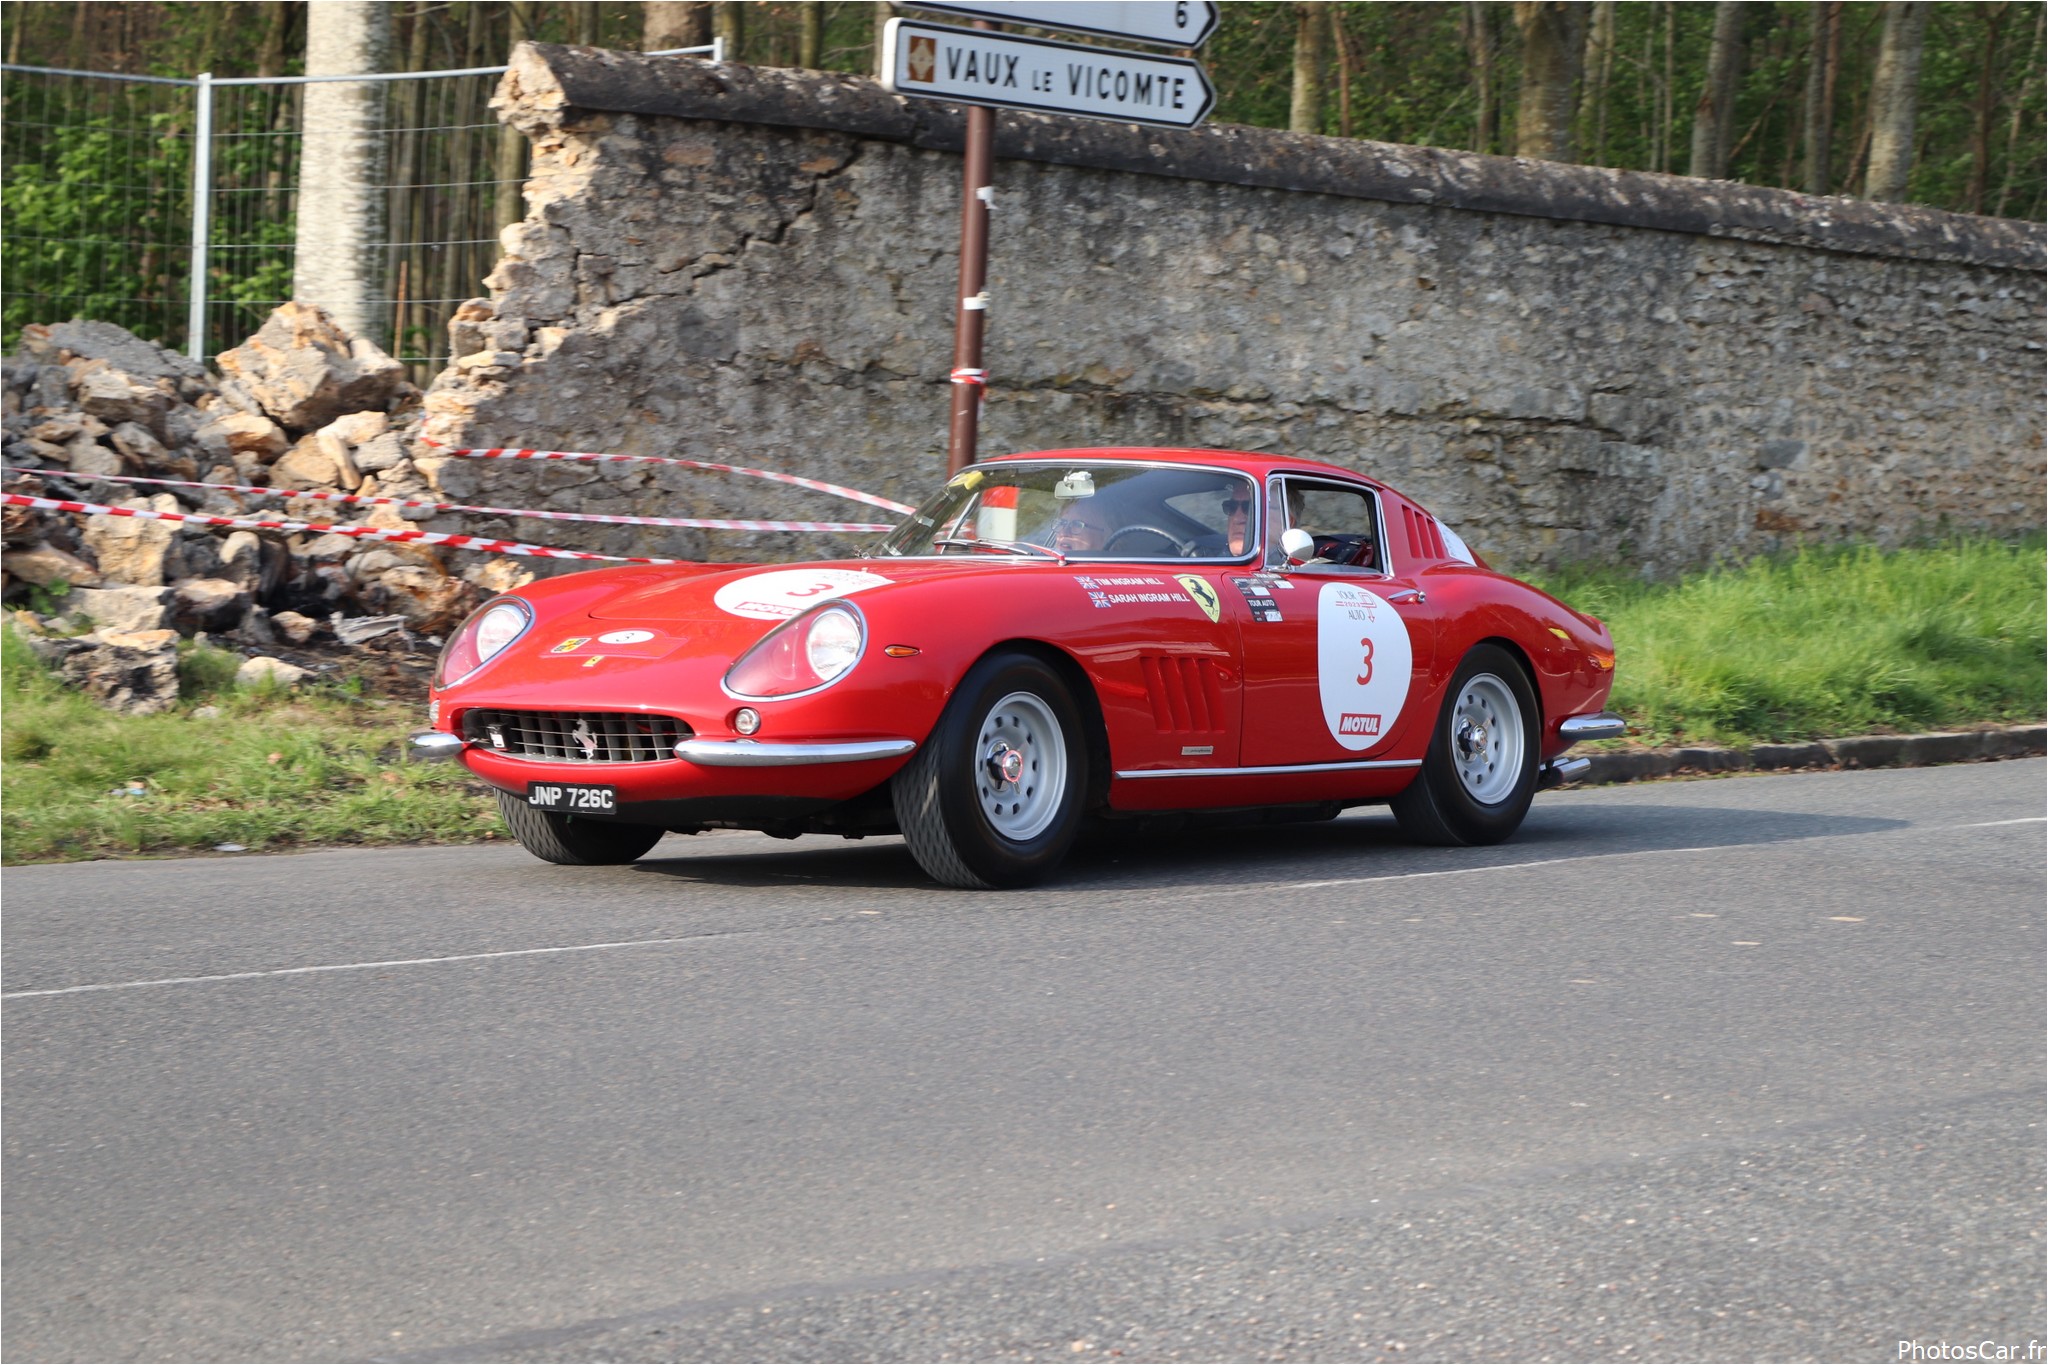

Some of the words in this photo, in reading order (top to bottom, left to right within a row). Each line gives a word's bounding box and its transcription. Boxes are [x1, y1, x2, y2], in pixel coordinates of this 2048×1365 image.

[1175, 1, 1189, 29] 6
[945, 46, 1020, 89] VAUX
[1032, 69, 1054, 94] LE
[1067, 63, 1187, 110] VICOMTE
[786, 583, 834, 597] 3
[1094, 578, 1111, 586] TIM
[1110, 578, 1145, 586] INGRAM
[1143, 577, 1165, 585] HILL
[1107, 594, 1138, 604] SARAH
[1138, 593, 1171, 603] INGRAM
[1170, 592, 1191, 602] HILL
[1356, 637, 1374, 686] 3
[1340, 716, 1379, 733] MOTUL
[528, 786, 562, 806] JNP
[566, 788, 614, 809] 726C
